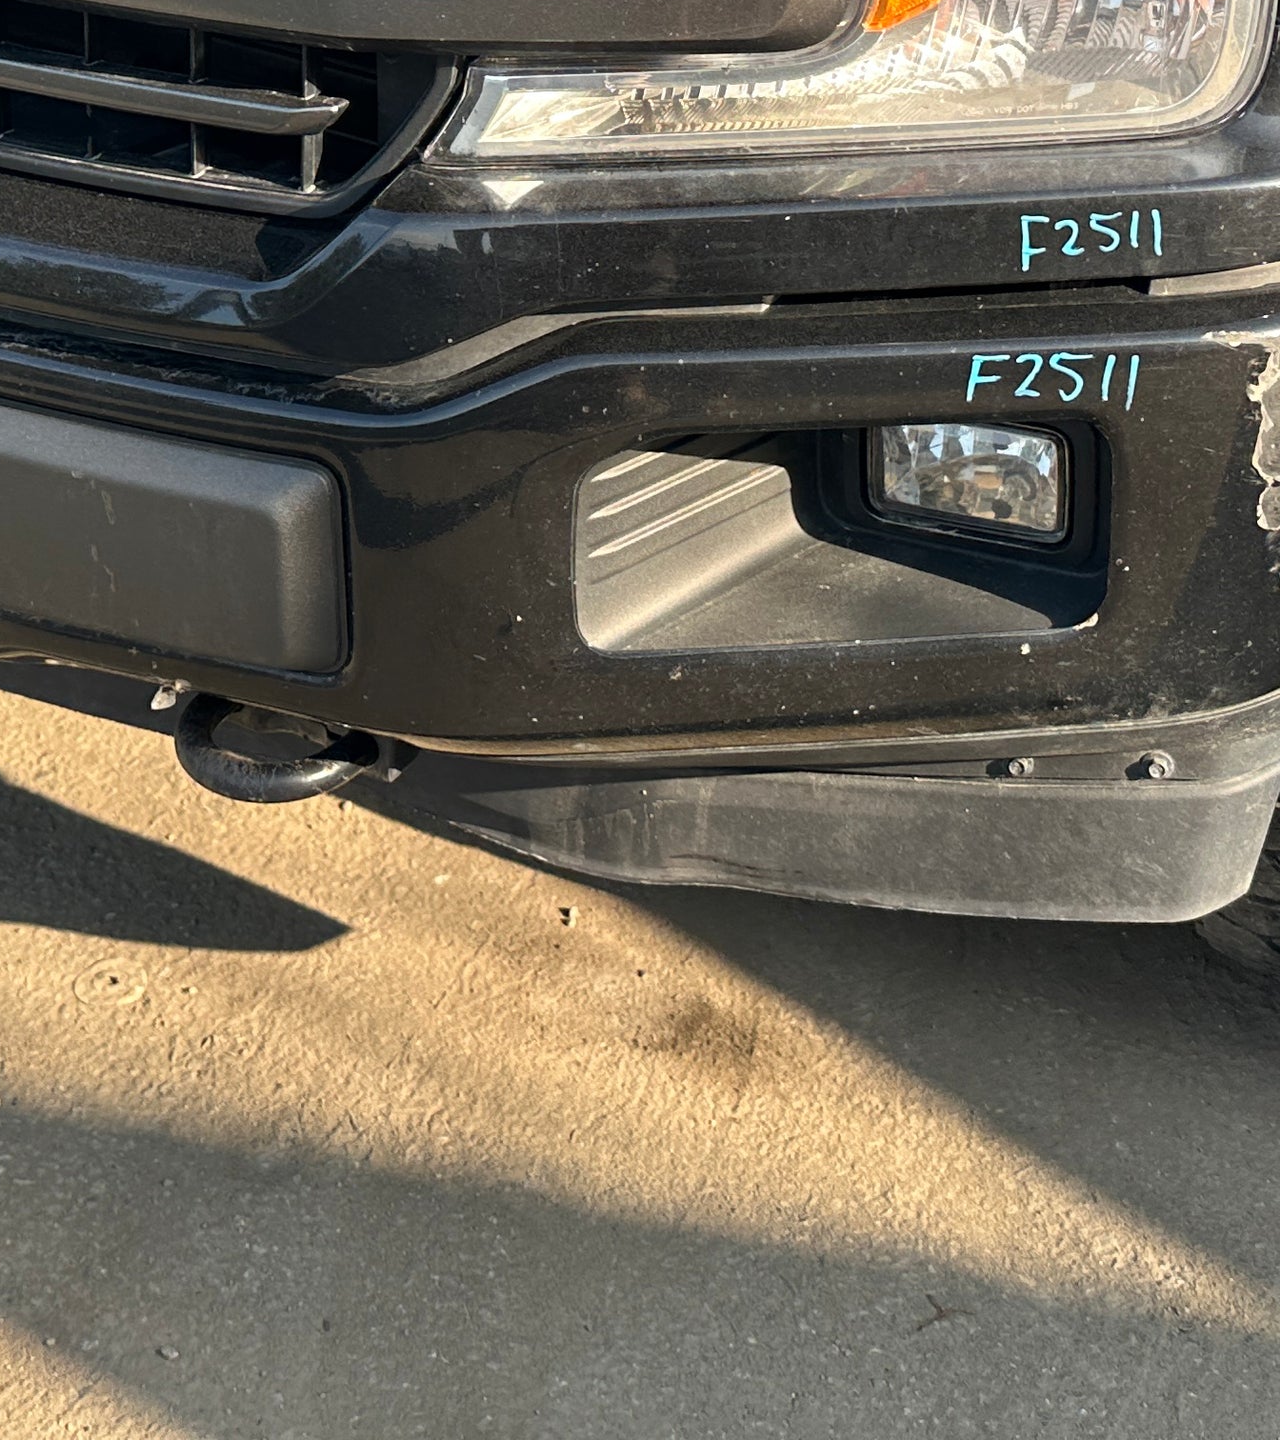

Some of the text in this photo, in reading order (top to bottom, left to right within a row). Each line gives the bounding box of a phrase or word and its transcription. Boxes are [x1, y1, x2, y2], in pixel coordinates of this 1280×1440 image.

[1016, 104, 1035, 113] DOT
[1020, 208, 1163, 272] F2511
[965, 351, 1141, 412] F2511
